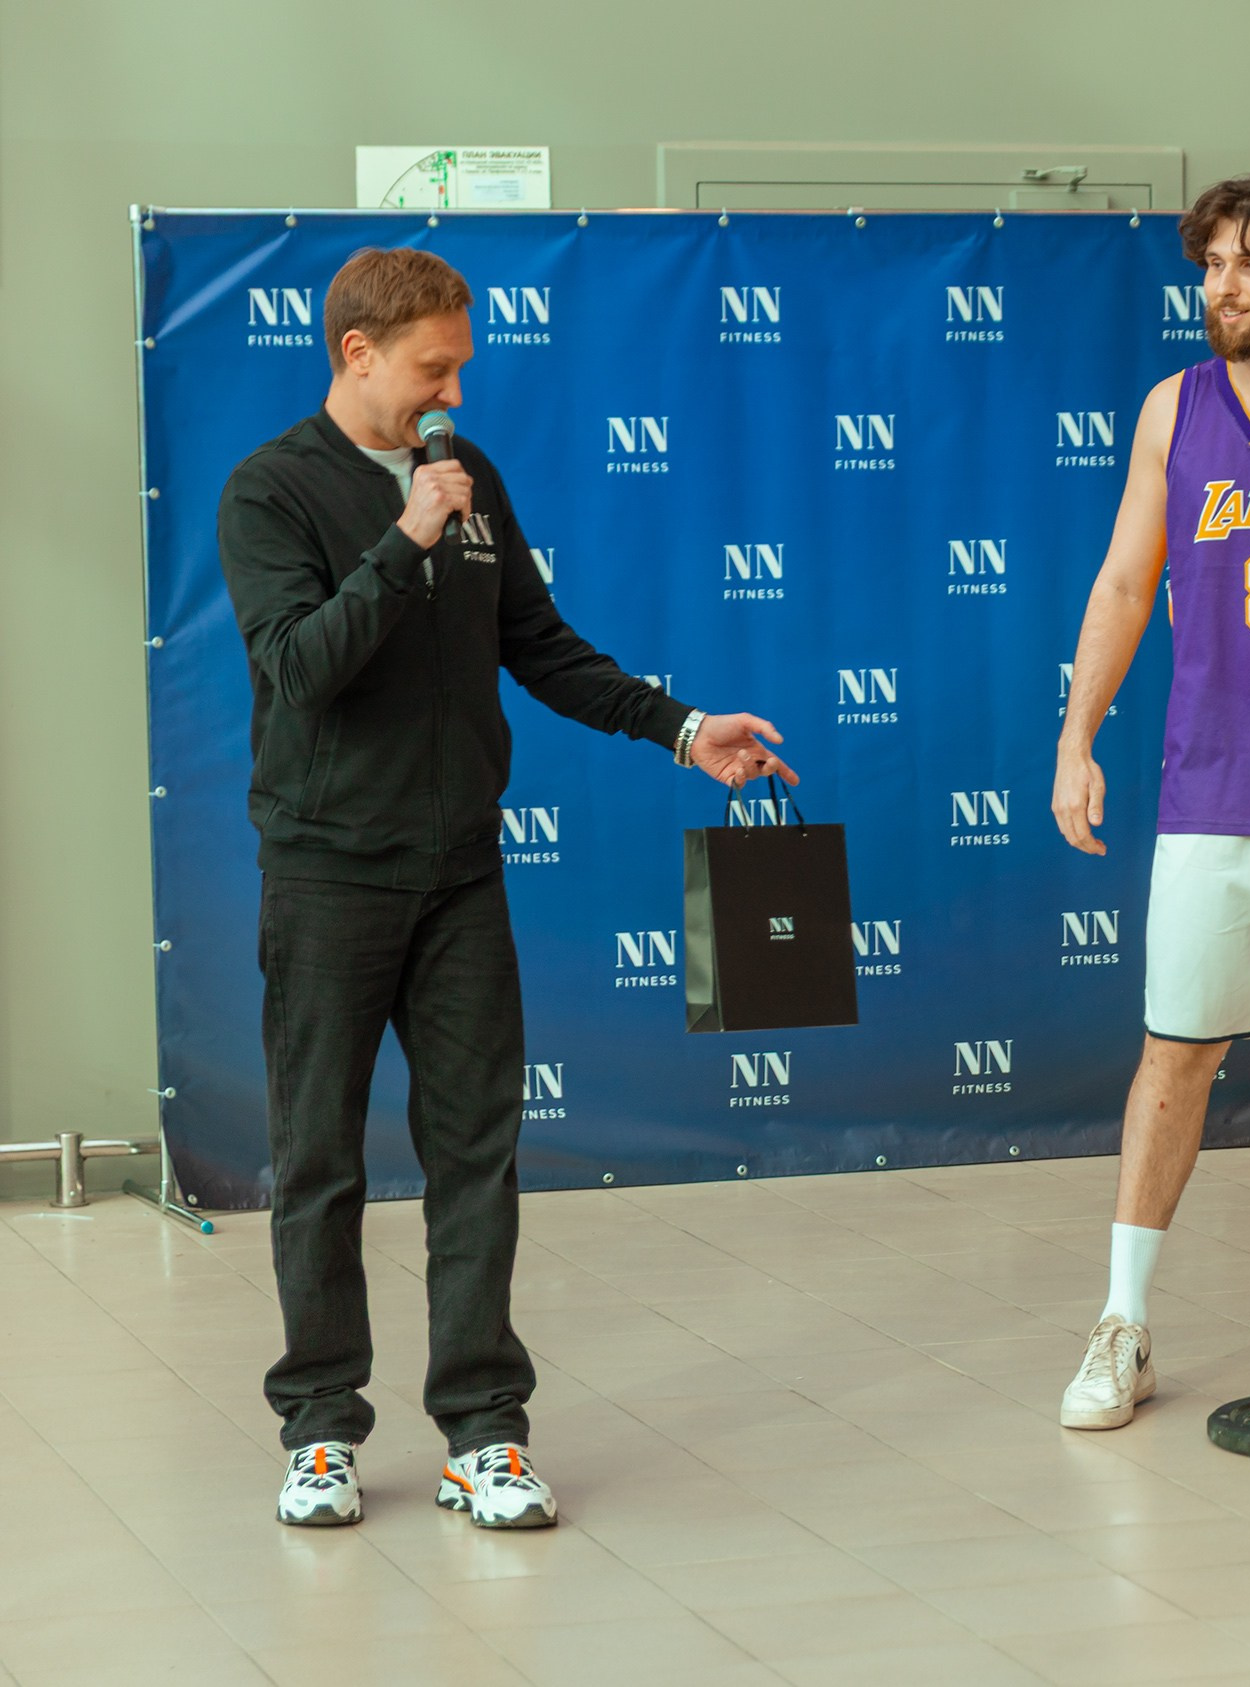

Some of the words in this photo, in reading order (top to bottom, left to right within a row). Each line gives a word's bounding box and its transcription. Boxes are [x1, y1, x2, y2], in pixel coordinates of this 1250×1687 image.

[248, 288, 311, 326] NN
[488, 288, 549, 323] NN
[721, 287, 780, 322] NN
[947, 287, 1003, 321] NN
[248, 335, 313, 345] FITNESS
[488, 333, 550, 344] FITNESS
[720, 332, 781, 342] FITNESS
[946, 331, 1004, 341] FITNESS
[1162, 329, 1209, 341] FITNE
[608, 417, 668, 452] NN
[836, 415, 894, 450] NN
[1057, 412, 1114, 446] NN
[607, 462, 668, 472] FITNESS
[835, 459, 895, 469] FITNESS
[1056, 456, 1115, 466] FITNESS
[724, 544, 783, 579] NN
[949, 540, 1006, 574] NN
[724, 589, 784, 599] FITNESS
[948, 584, 1006, 594] FITNESS
[838, 668, 897, 704] NN
[838, 713, 897, 724] FITNESS
[951, 791, 1009, 826] NN
[498, 807, 560, 844] NN
[951, 834, 1009, 846] FITNESS
[768, 916, 795, 933] NN
[1062, 910, 1119, 946] NN
[616, 931, 676, 967] NN
[1062, 954, 1119, 965] FITNESS
[856, 964, 902, 976] TNESS
[616, 975, 676, 987] FITNESS
[954, 1040, 1012, 1076] NN
[731, 1052, 791, 1088] NN
[953, 1083, 1011, 1094] FITNESS
[730, 1095, 789, 1107] FITNESS
[522, 1107, 566, 1121] TNESS
